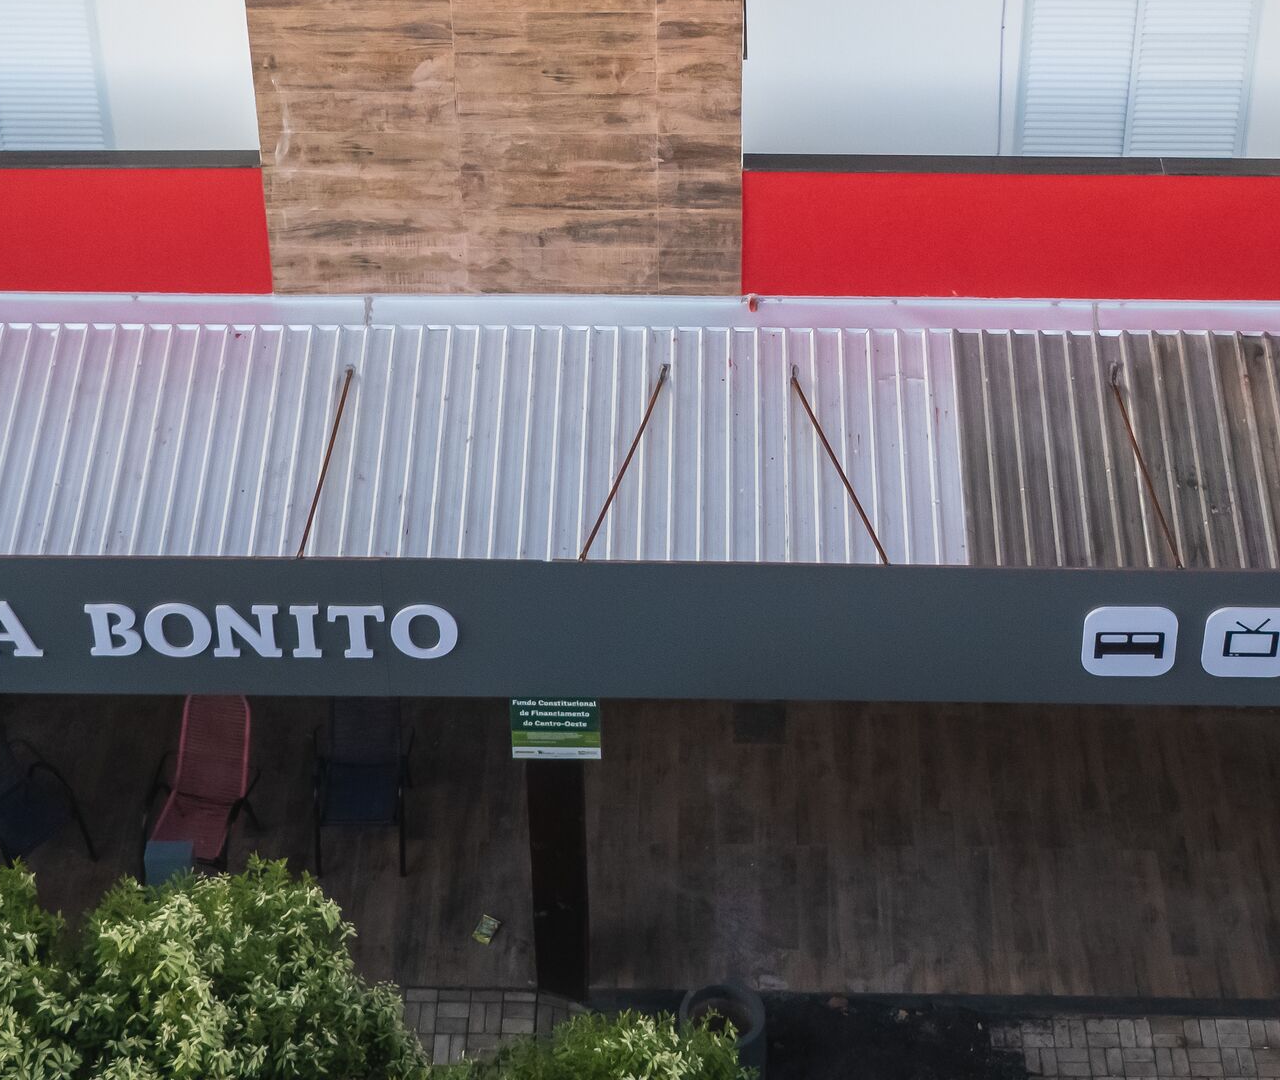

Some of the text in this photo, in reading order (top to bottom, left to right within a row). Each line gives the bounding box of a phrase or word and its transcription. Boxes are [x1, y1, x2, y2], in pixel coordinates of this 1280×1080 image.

[84, 602, 460, 660] BONITO
[512, 699, 596, 708] Fundo Constitucional
[519, 709, 590, 718] de Financiamento
[534, 720, 588, 728] Centro-Oeste
